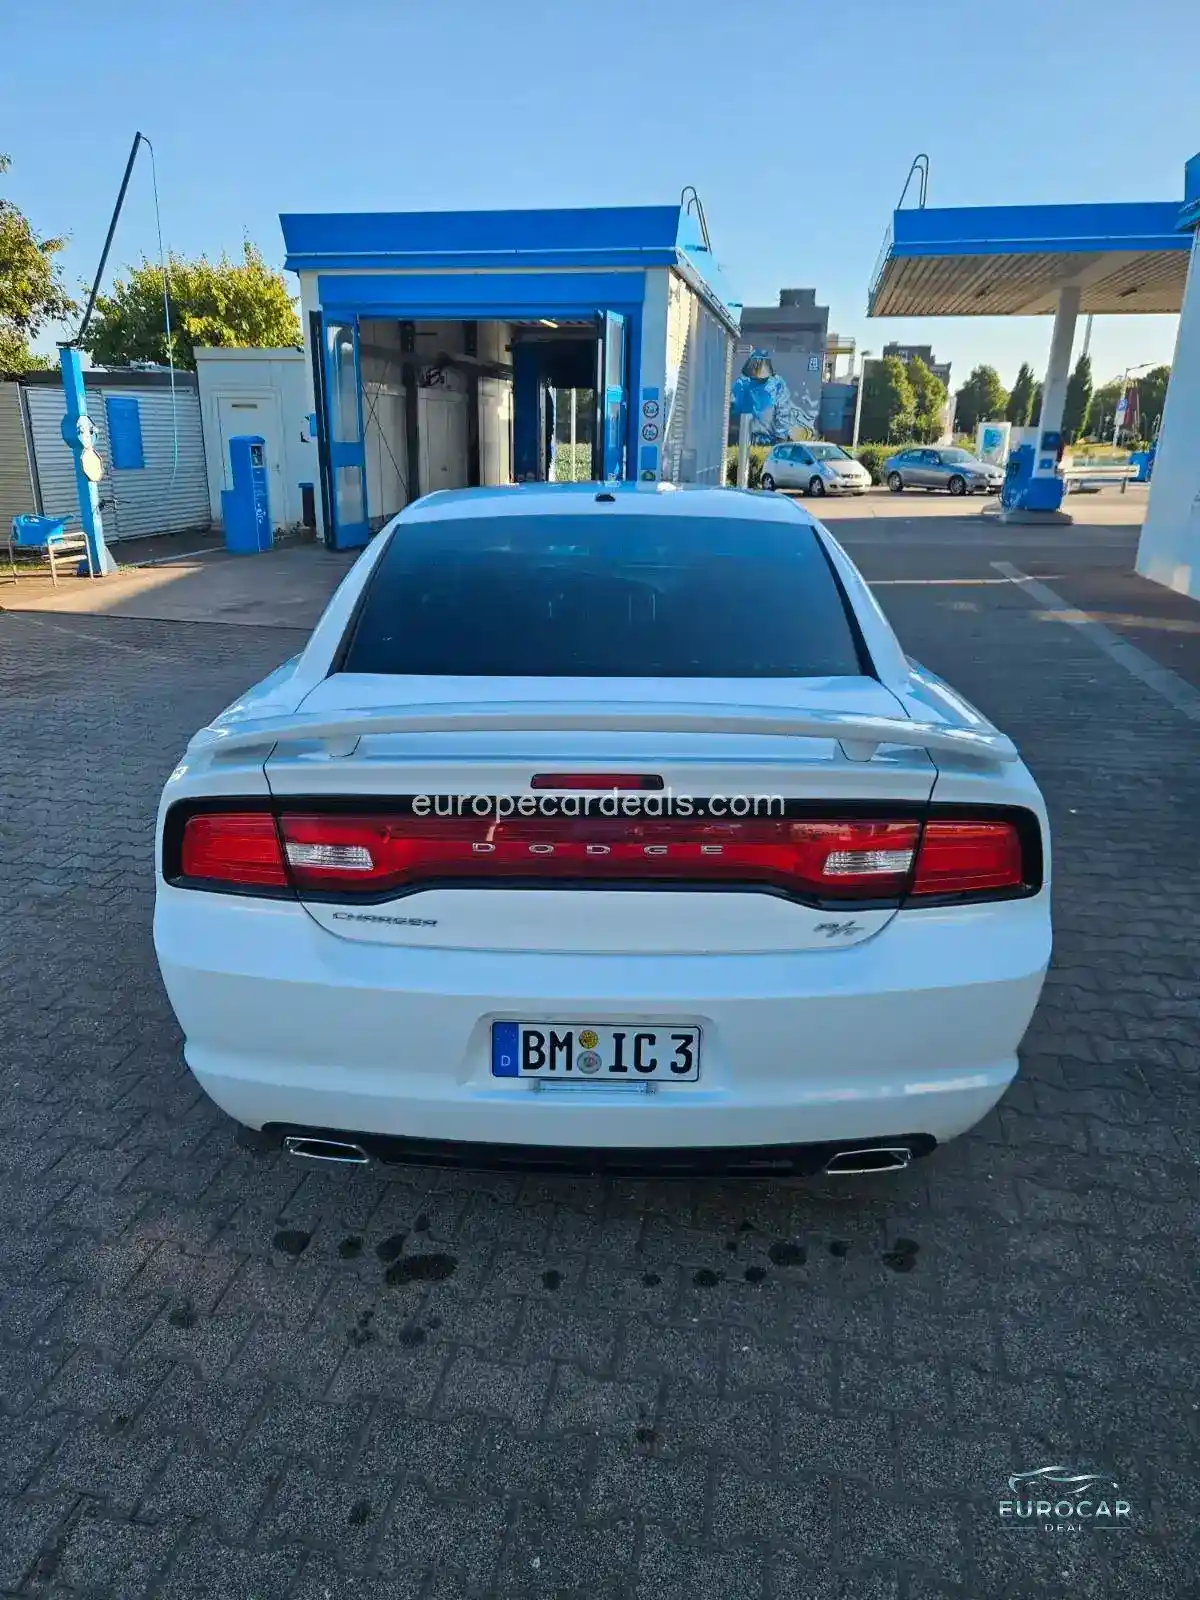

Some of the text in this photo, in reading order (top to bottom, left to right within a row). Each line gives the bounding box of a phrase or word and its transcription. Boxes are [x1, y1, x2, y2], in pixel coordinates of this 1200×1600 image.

[471, 842, 725, 856] DODGE
[332, 912, 438, 928] CHARGER
[522, 1030, 694, 1074] BM IC 3
[501, 1055, 511, 1067] D
